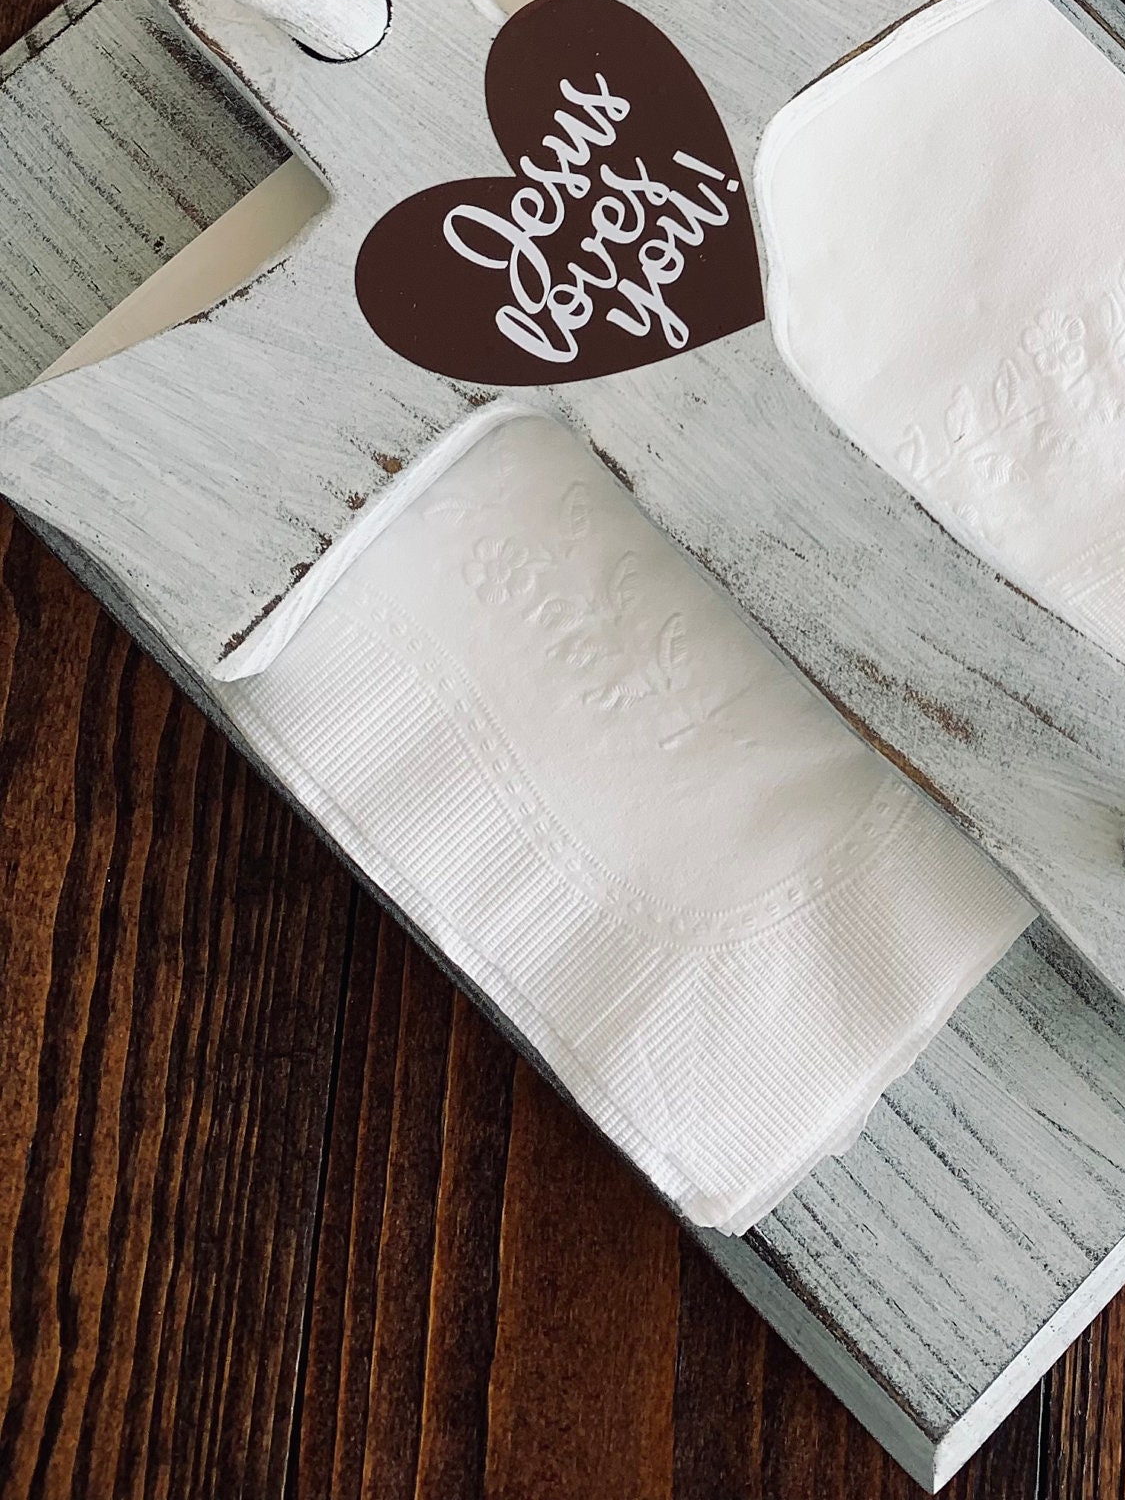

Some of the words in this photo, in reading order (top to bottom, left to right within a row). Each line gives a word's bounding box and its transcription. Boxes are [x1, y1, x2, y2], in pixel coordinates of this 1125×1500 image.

[443, 73, 631, 315] Jesus
[495, 157, 672, 363] loves
[606, 150, 740, 350] you!
